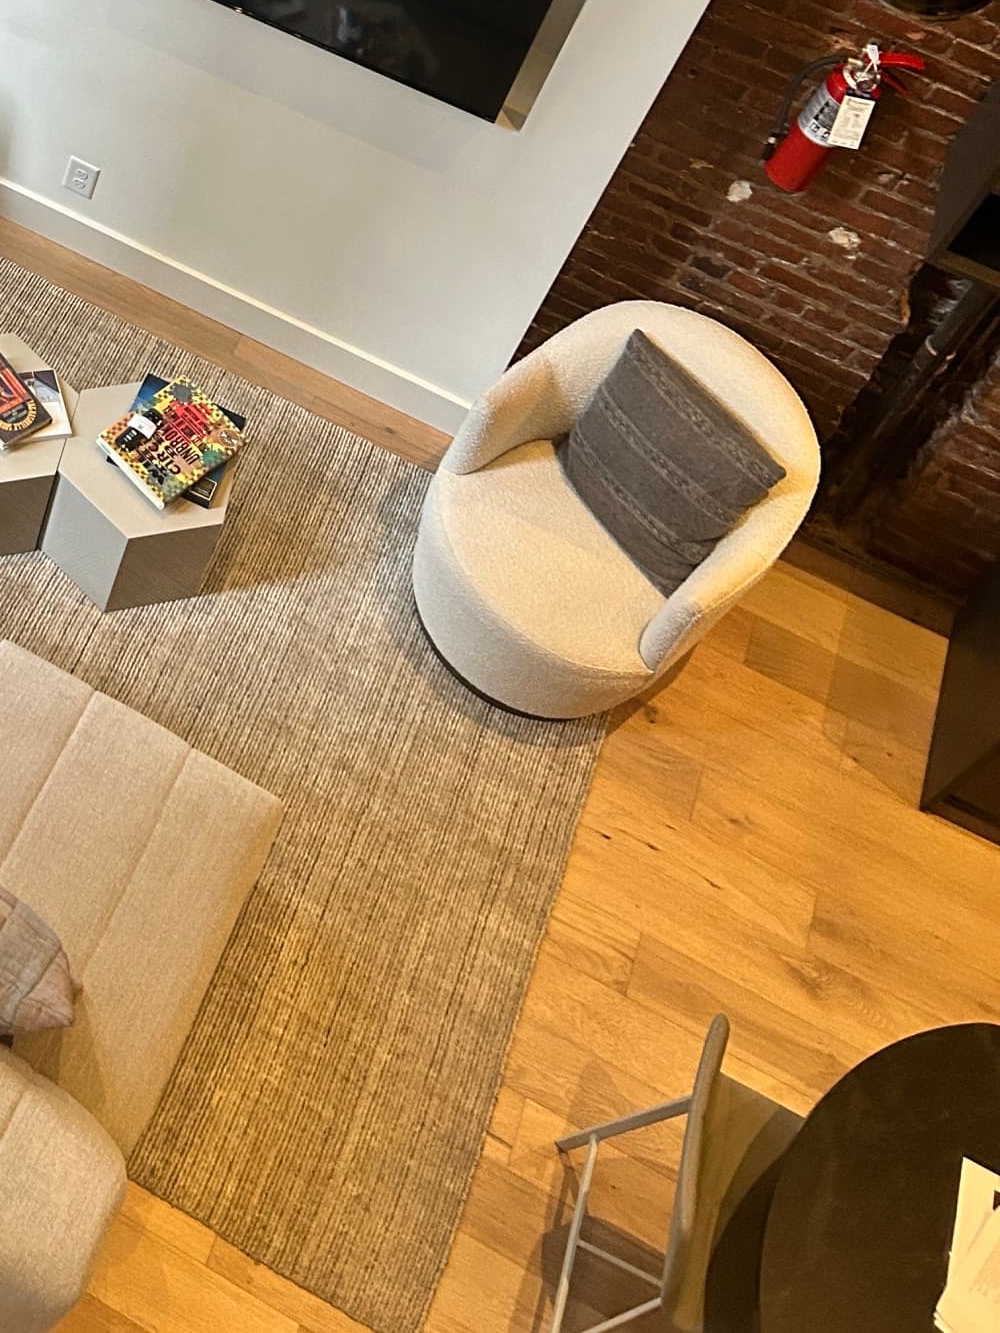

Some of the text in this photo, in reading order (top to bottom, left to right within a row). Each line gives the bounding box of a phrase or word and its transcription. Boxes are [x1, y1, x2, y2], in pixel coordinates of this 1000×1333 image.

[137, 443, 170, 478] TH
[144, 437, 182, 477] CIRC
[157, 421, 200, 465] UNBROK
[132, 449, 164, 485] WIL
